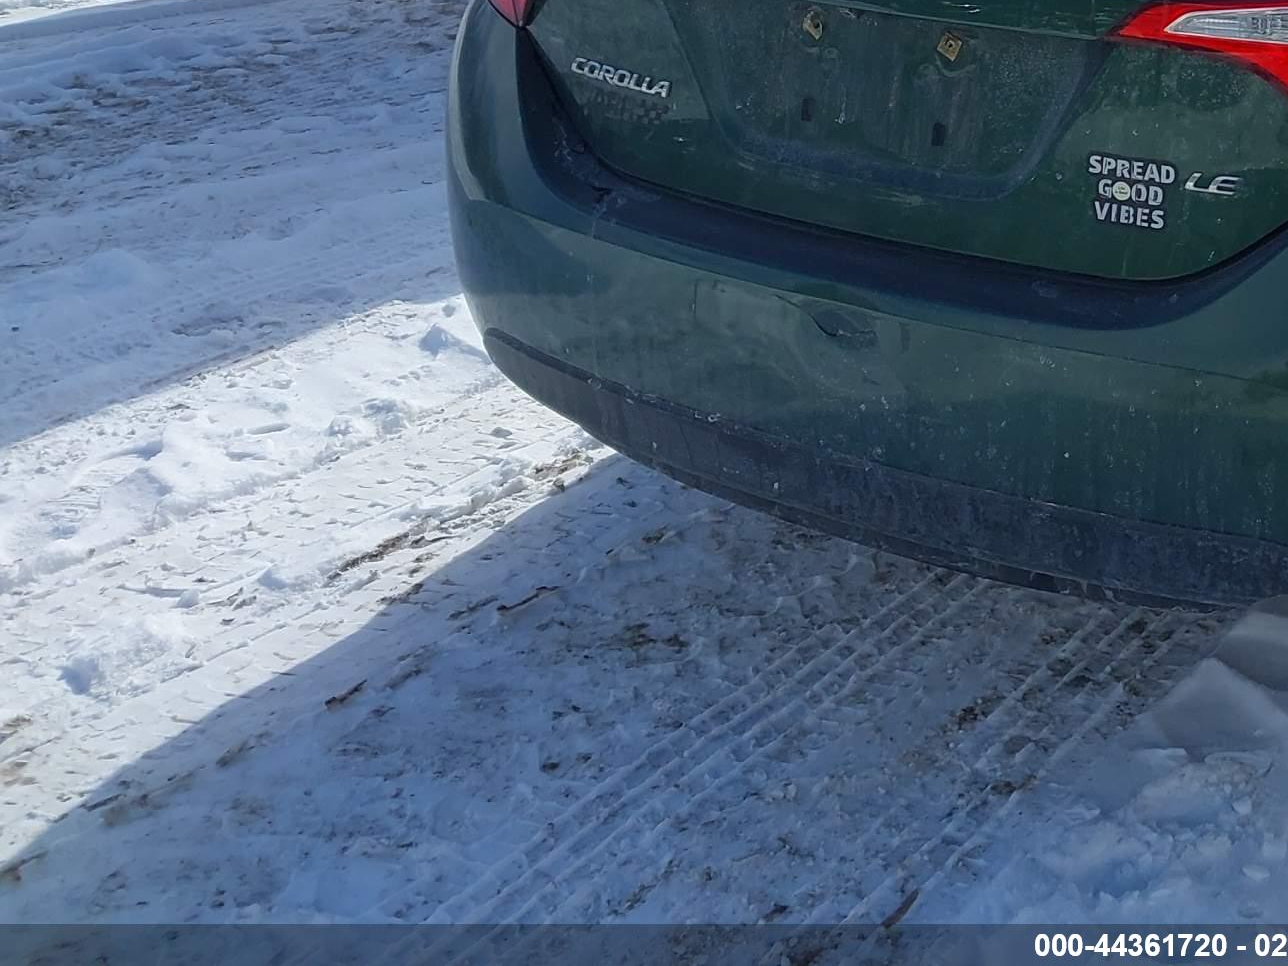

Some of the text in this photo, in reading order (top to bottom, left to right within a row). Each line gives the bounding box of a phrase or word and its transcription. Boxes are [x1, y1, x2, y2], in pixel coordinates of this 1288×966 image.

[571, 57, 671, 98] COROLLA
[1088, 155, 1176, 184] SPREAD
[1098, 179, 1164, 206] GOOD
[1184, 172, 1242, 196] LE
[1094, 201, 1165, 229] VIBES
